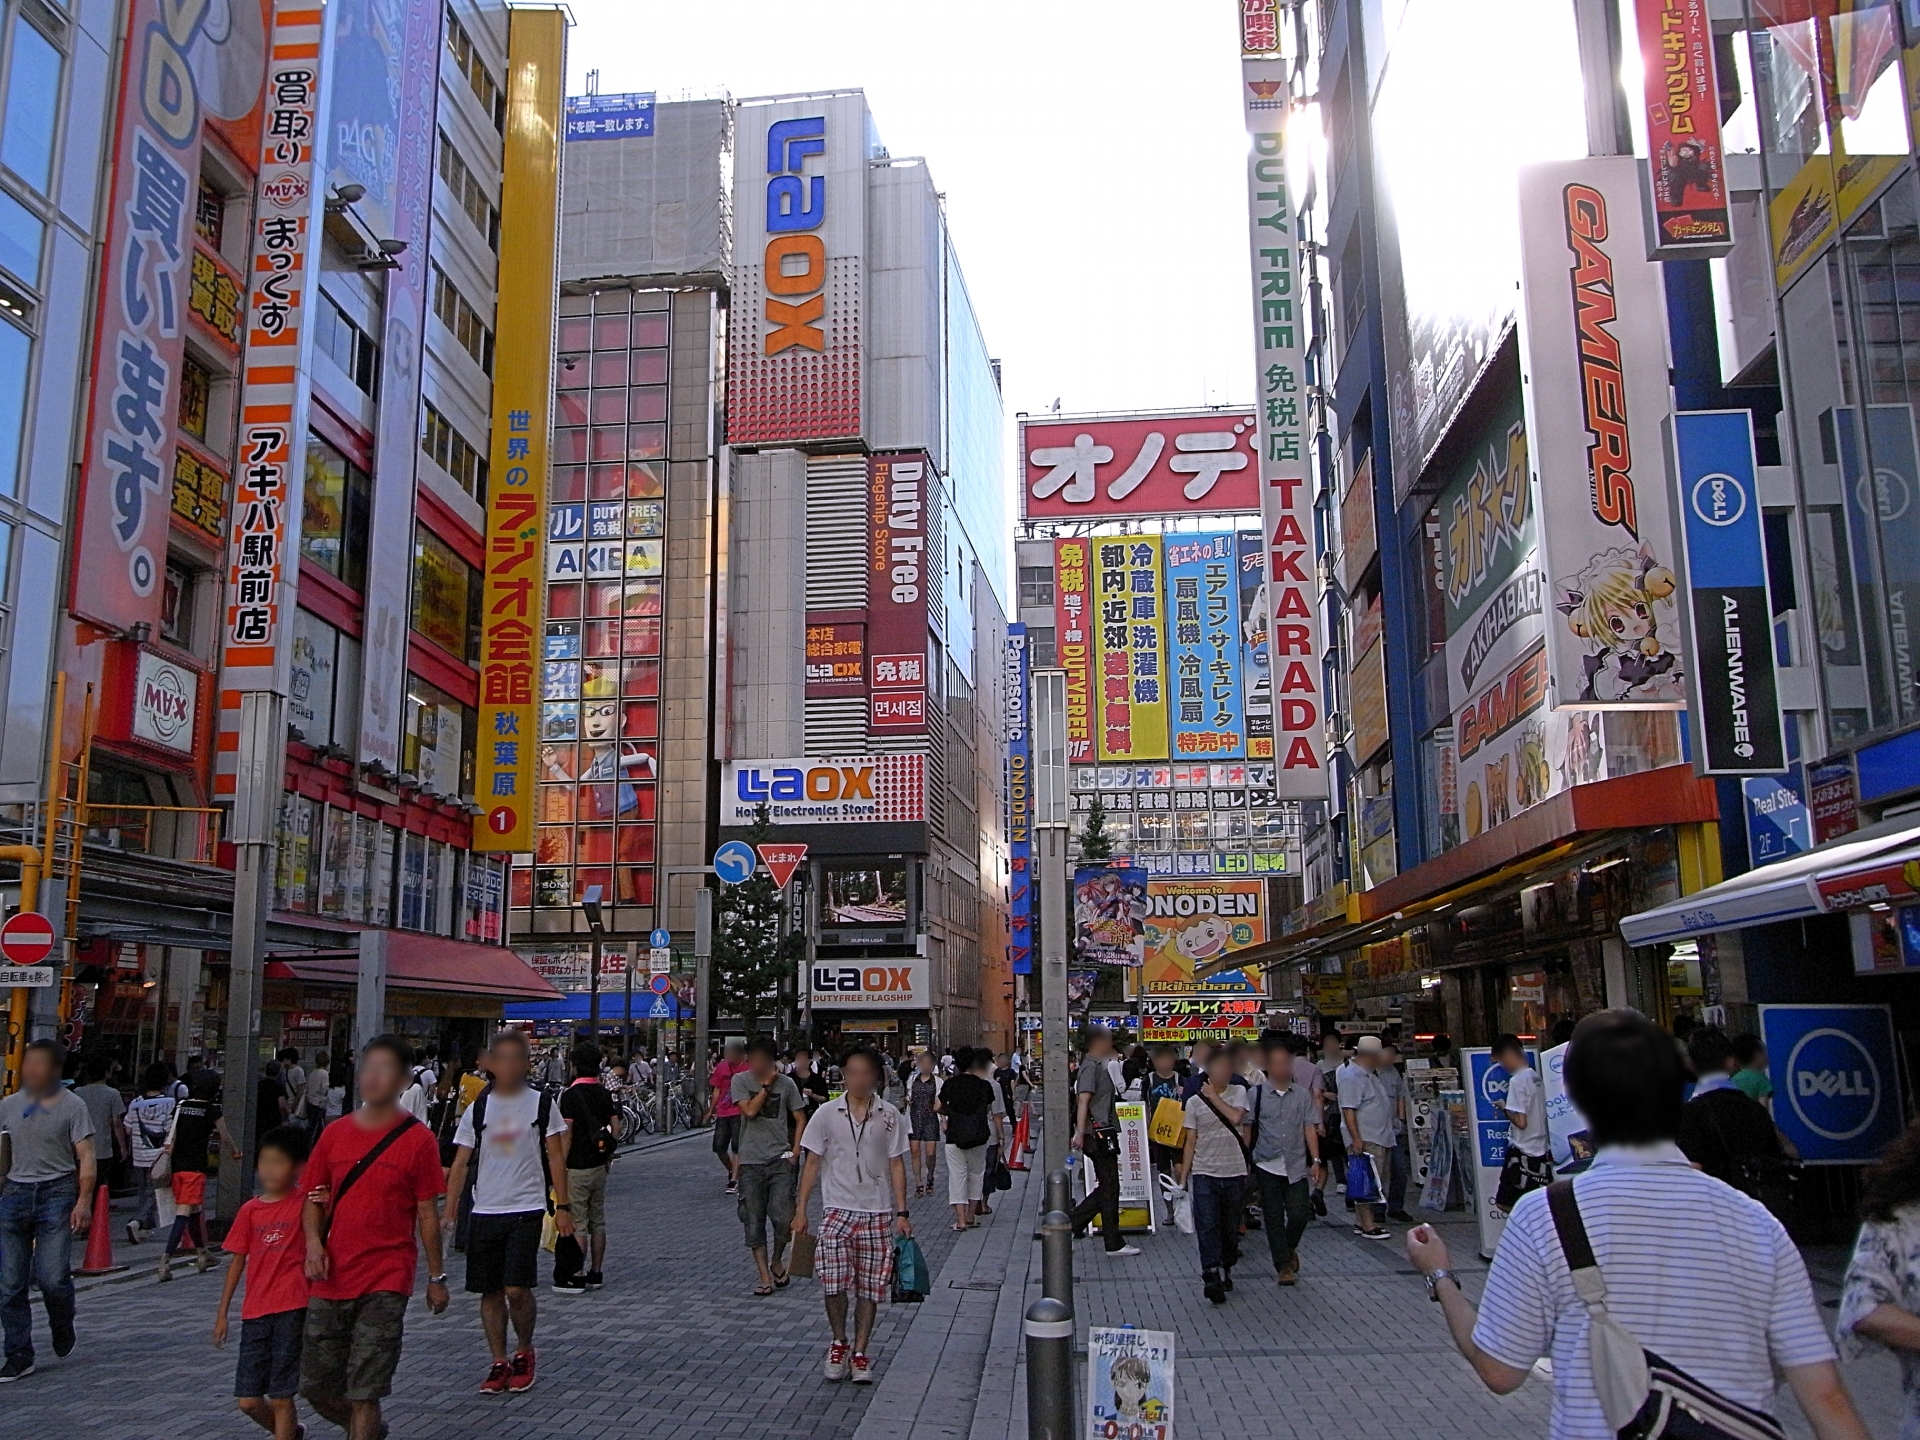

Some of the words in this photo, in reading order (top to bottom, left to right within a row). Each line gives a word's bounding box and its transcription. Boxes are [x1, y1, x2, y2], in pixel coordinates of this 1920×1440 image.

[1254, 132, 1288, 234] DUTY
[1259, 248, 1293, 349] FREE
[1563, 183, 1640, 542] GAMERS
[1264, 364, 1299, 461] 免税店
[1030, 416, 1260, 503] オノデ
[872, 463, 888, 524] Flagship
[888, 461, 923, 530] Duty
[1711, 480, 1728, 520] DELL
[593, 507, 622, 519] DUTY
[628, 505, 657, 517] FREE
[555, 545, 650, 573] AKIBA
[875, 529, 888, 571] Store
[891, 536, 924, 603] Free
[1059, 543, 1084, 593] 免税
[807, 627, 834, 641] 本店
[1129, 543, 1159, 703] 冷蔵庫洗濯機
[1270, 479, 1320, 769] TAKARADA
[876, 661, 920, 682] 免税
[1722, 595, 1749, 743] ALIENWARE
[1008, 634, 1025, 741] Panasonic
[875, 699, 921, 717] 면세점
[1177, 731, 1239, 753] 特売中
[773, 804, 838, 817] Electronics
[842, 803, 875, 815] Store
[1011, 754, 1027, 842] ONODEN
[1754, 794, 1777, 816] Real
[1778, 789, 1799, 809] Site
[1759, 833, 1771, 853] 2F
[767, 853, 797, 863] 止まれ
[542, 881, 570, 889] SONY
[1166, 886, 1209, 895] Welcome
[1212, 886, 1223, 895] to
[0, 970, 50, 984] 自転車を除く
[1150, 980, 1246, 991] Akihabara
[866, 994, 912, 1002] FLAGSHIP
[1152, 1014, 1244, 1028] オノデン
[1190, 1029, 1227, 1040] ONODEN
[1797, 1069, 1871, 1099] DELL
[1490, 1147, 1504, 1157] 2F
